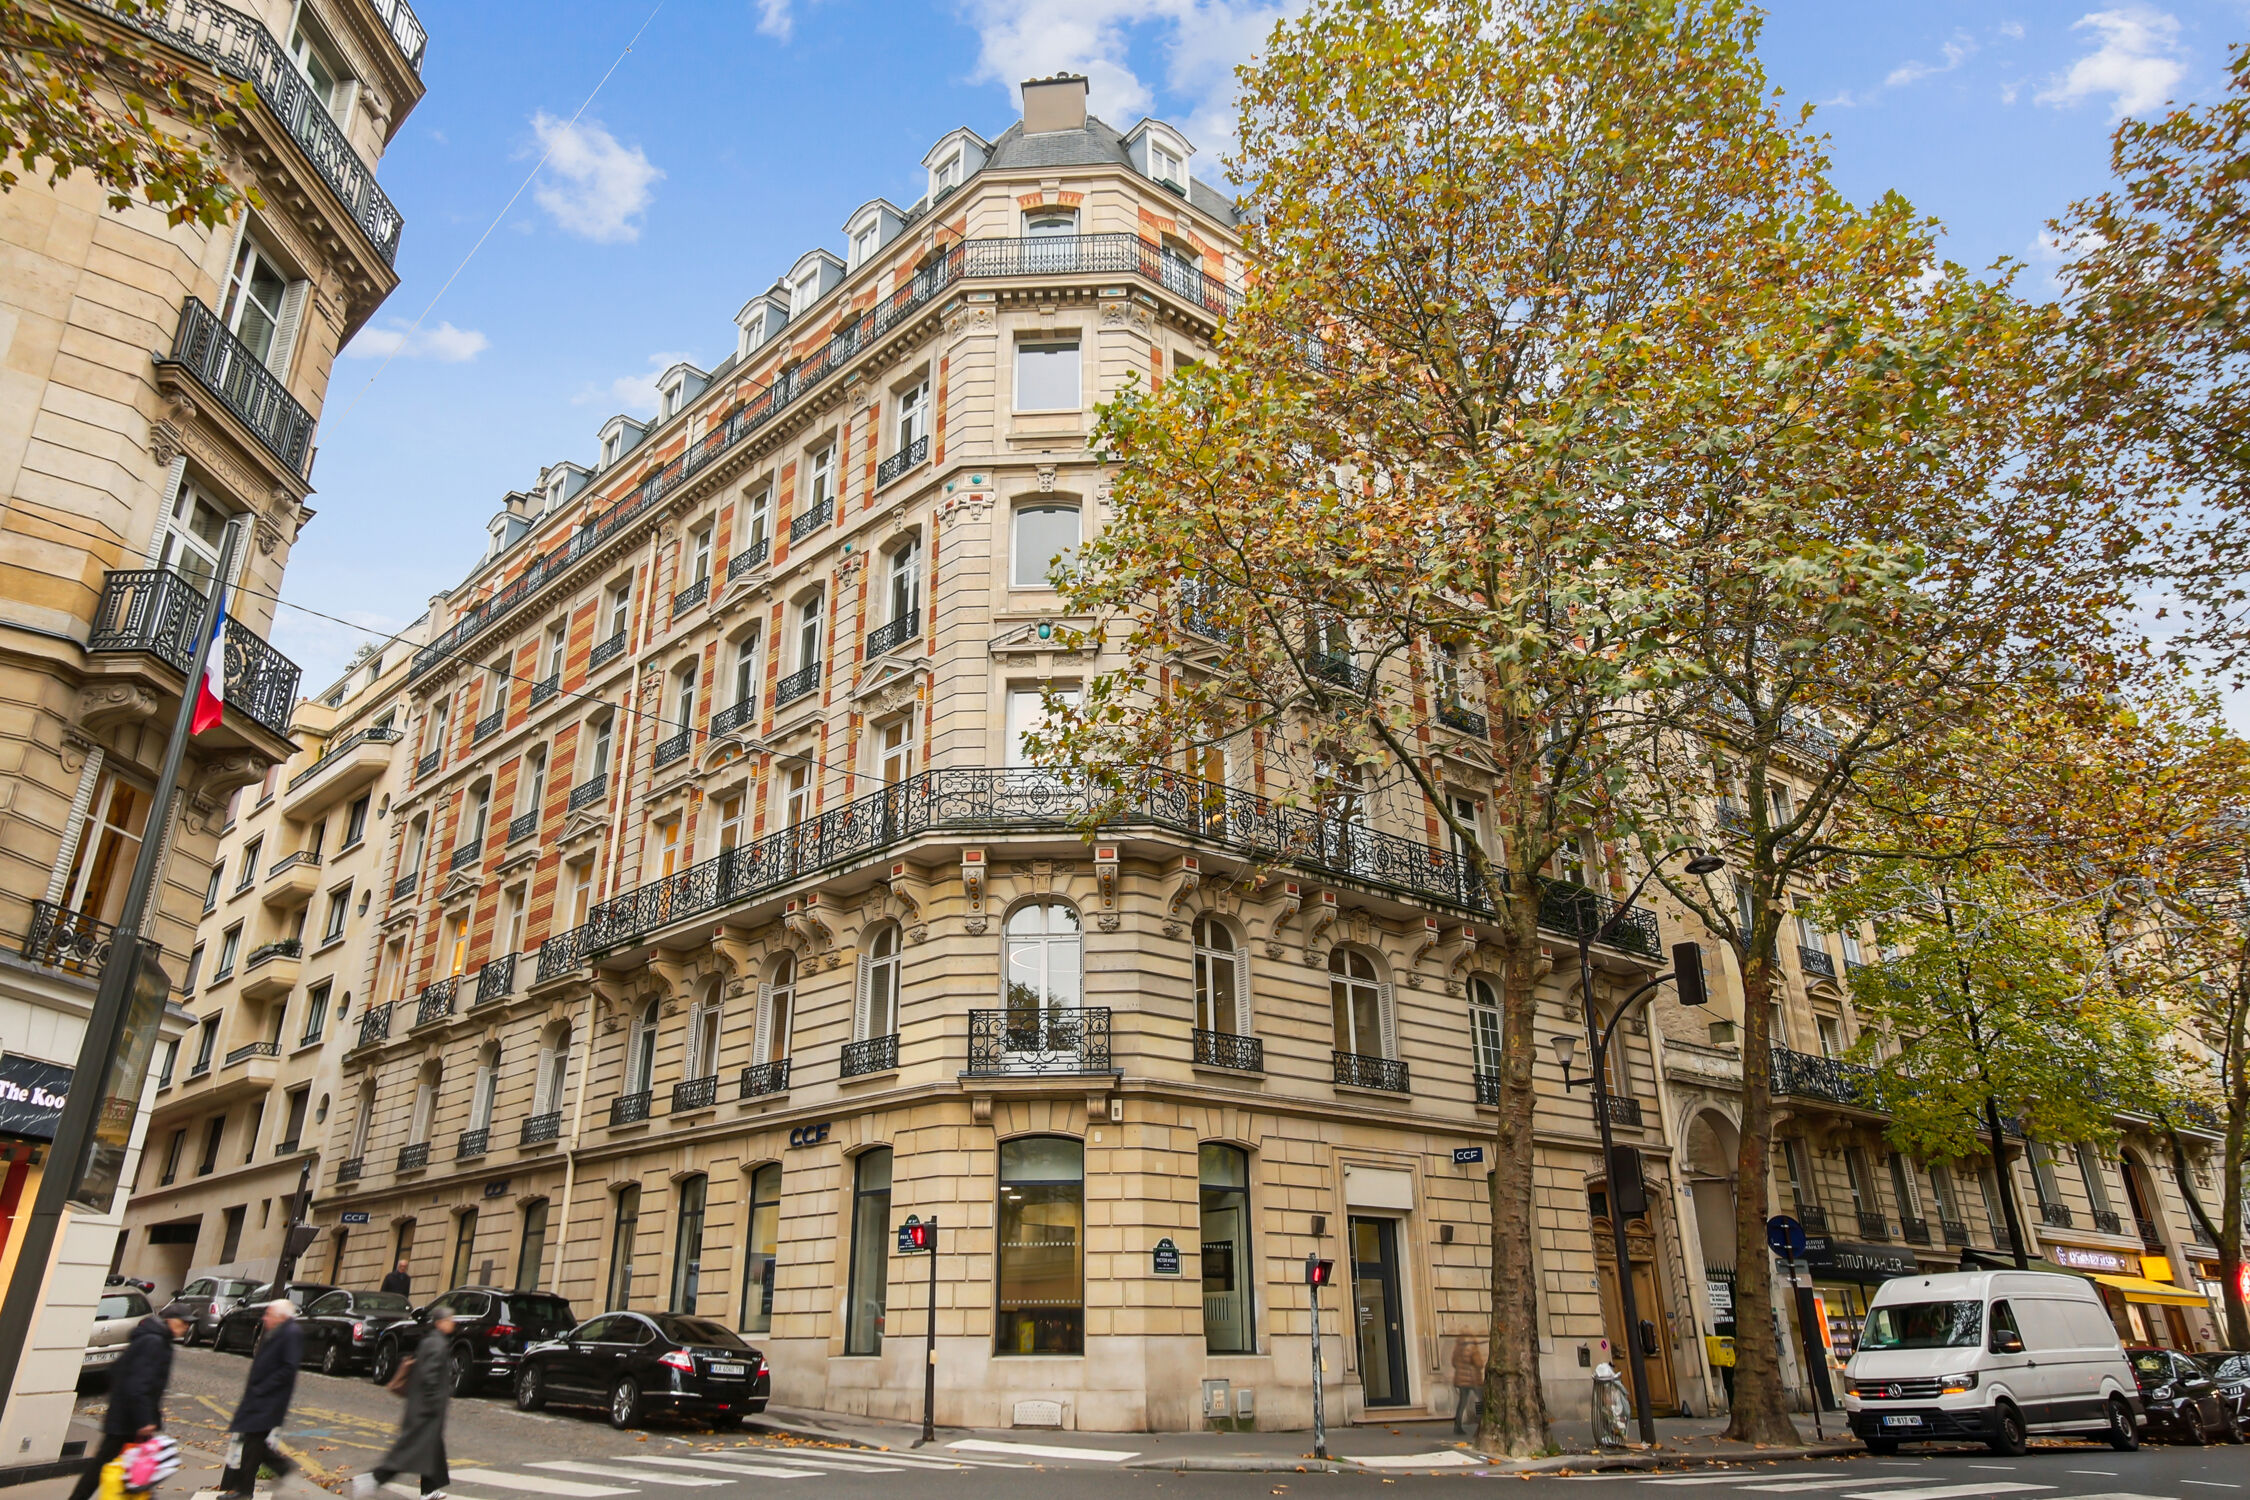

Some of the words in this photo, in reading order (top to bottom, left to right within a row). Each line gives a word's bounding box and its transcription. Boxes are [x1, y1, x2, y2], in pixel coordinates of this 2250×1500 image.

[0, 1079, 29, 1102] The
[30, 1086, 66, 1109] Koo
[789, 1122, 832, 1147] CCF
[1456, 1150, 1479, 1160] CCF
[484, 1180, 510, 1197] CCF
[344, 1214, 366, 1222] CCF
[1836, 1253, 1864, 1270] STITUT
[1866, 1255, 1903, 1272] MAHLER
[1711, 1283, 1729, 1292] LOUER
